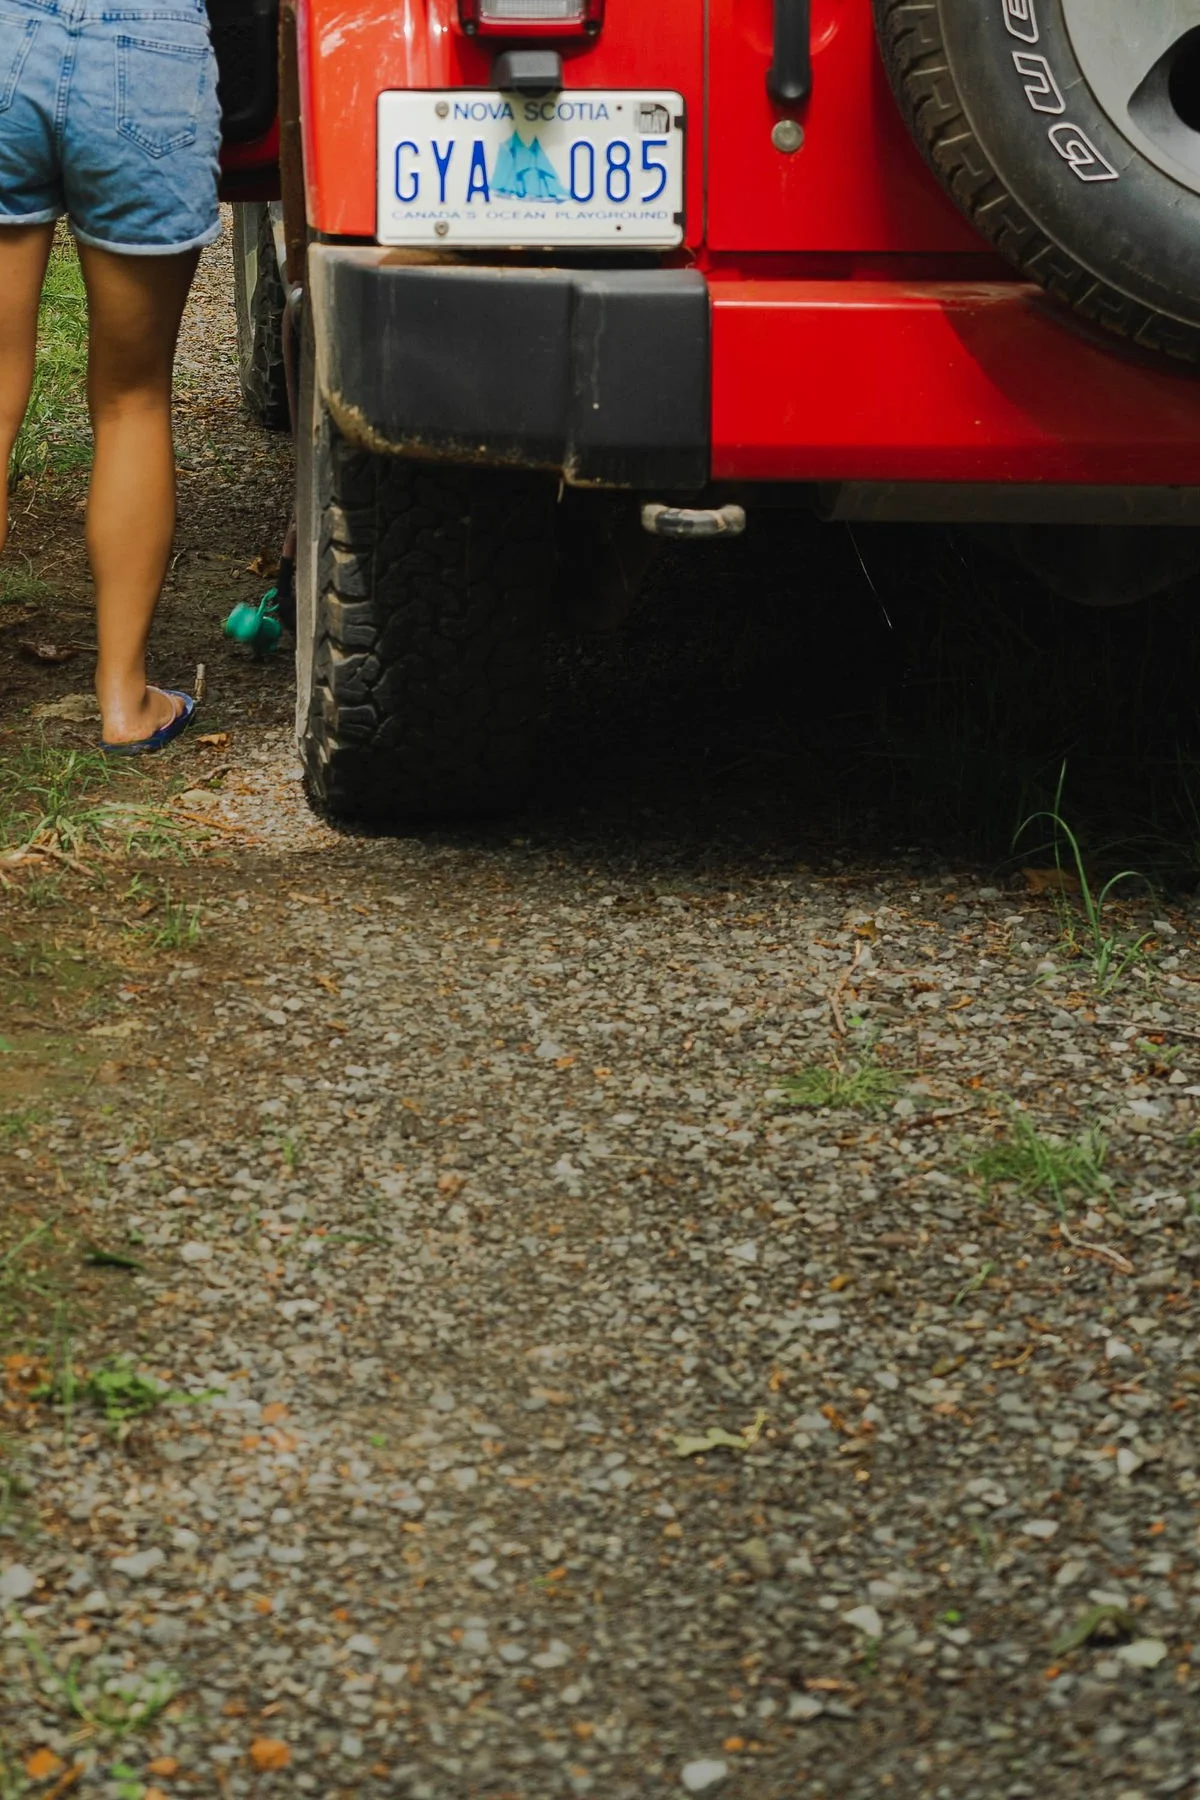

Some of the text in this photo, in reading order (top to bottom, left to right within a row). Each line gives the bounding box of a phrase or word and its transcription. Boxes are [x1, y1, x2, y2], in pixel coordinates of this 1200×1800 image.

[453, 101, 609, 121] NOVA SCOTIA
[394, 140, 669, 203] GYA 085
[486, 210, 546, 220] OCEAN
[554, 210, 669, 220] PLAYGROUND
